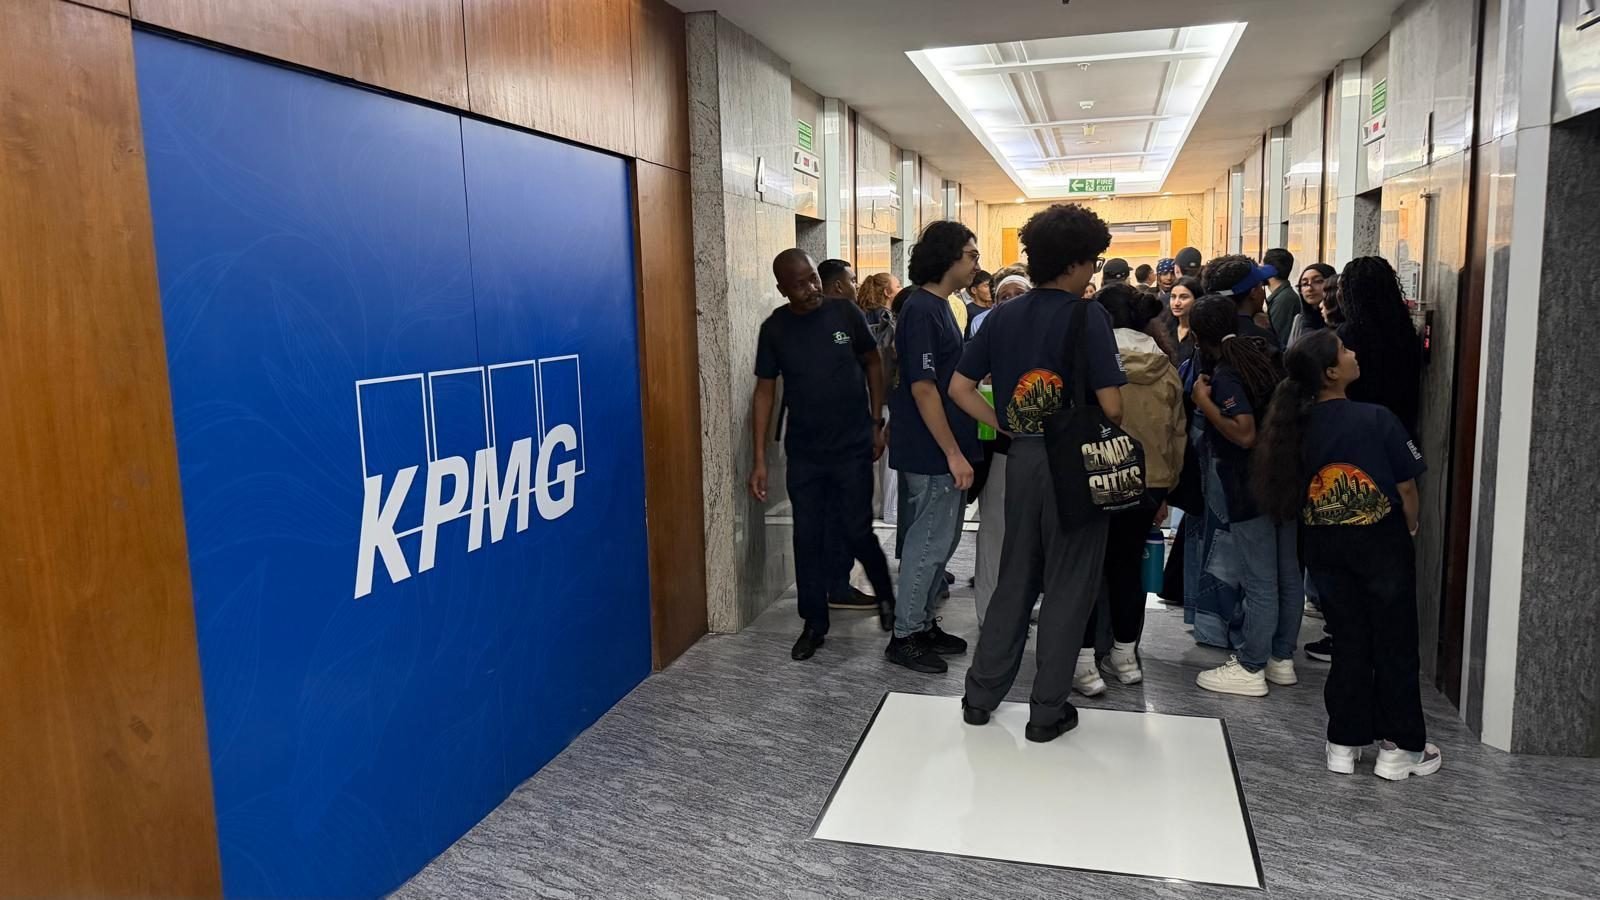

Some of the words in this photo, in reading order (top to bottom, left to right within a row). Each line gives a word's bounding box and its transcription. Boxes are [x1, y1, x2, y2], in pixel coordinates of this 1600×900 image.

[1081, 435, 1135, 469] CLIMATE
[1088, 465, 1144, 504] CITIES
[354, 423, 577, 599] KPMG
